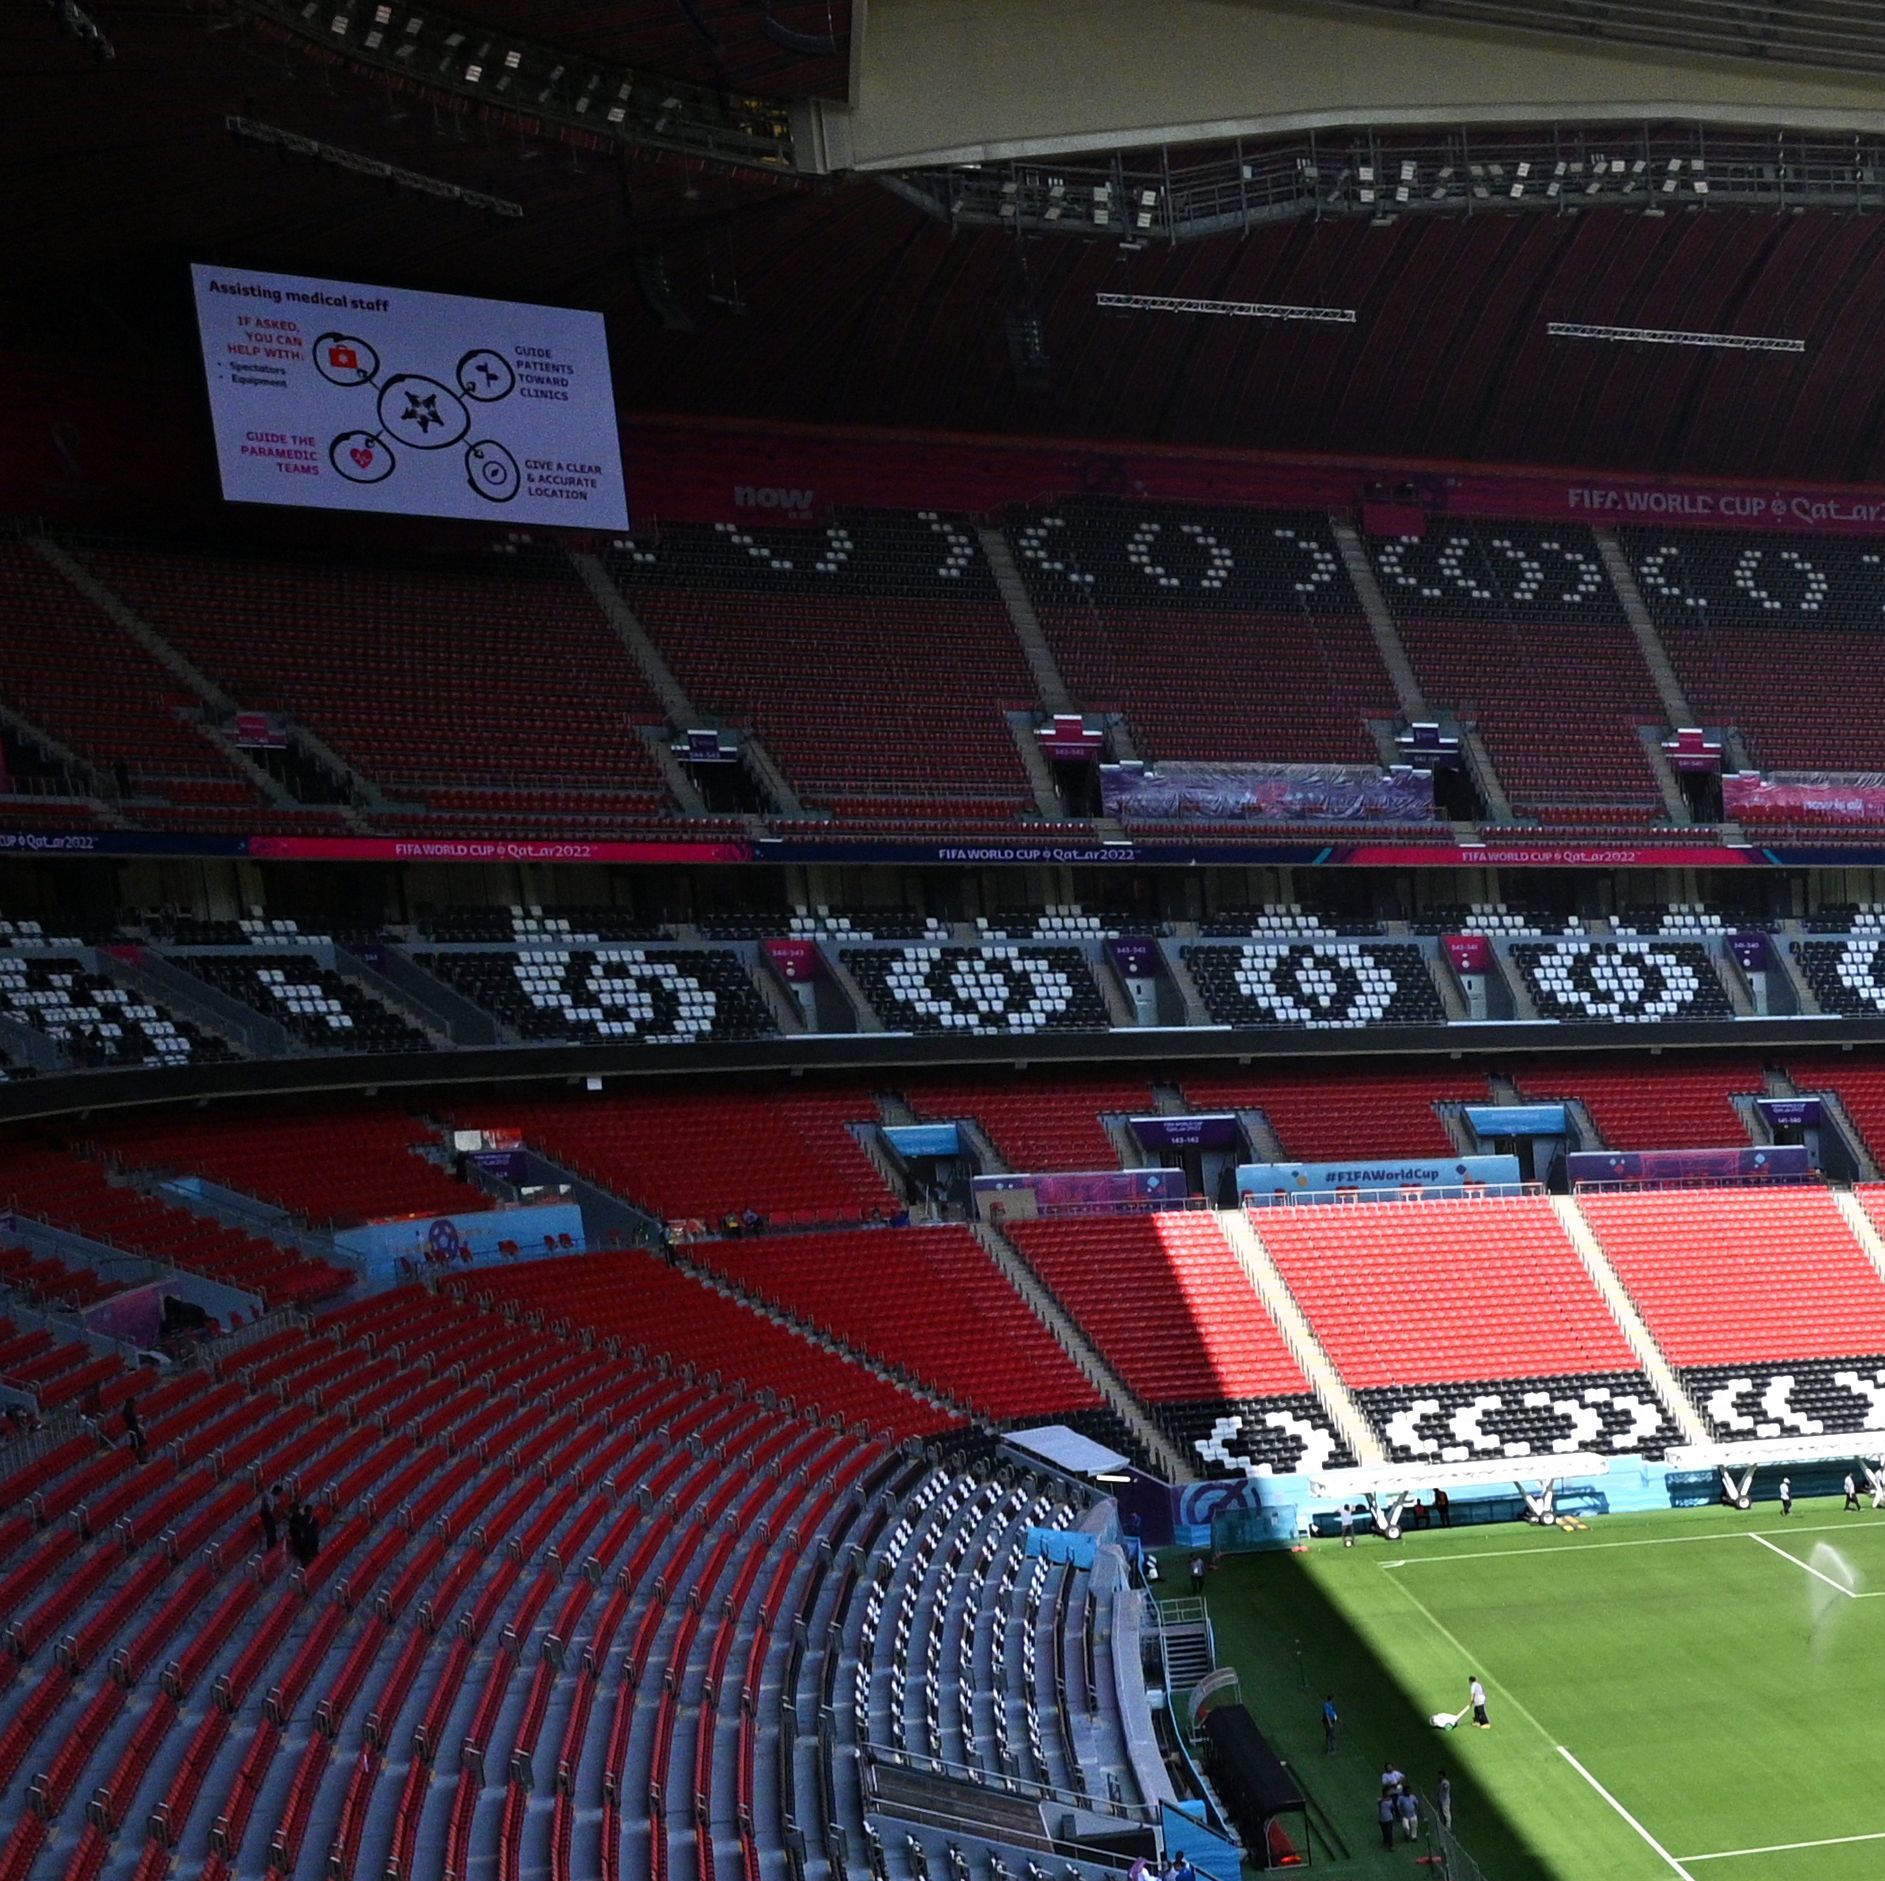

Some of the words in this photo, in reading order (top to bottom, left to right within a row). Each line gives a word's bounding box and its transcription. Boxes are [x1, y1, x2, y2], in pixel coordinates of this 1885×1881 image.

[209, 280, 282, 304] Assisting
[286, 291, 347, 308] medical
[351, 298, 389, 313] staff
[238, 316, 254, 326] IF
[246, 331, 273, 343] YOU
[276, 335, 302, 347] CAN
[228, 344, 260, 356] HELP
[515, 345, 552, 359] GUIDE
[229, 361, 286, 376] Spectators
[516, 359, 574, 375] PATIENTS
[231, 374, 288, 389] Equipment
[518, 373, 569, 388] TOWARD
[520, 387, 569, 401] CLINICS
[246, 431, 288, 444] GUIDE
[291, 435, 316, 447] THE
[241, 445, 318, 461] PARAMEDIC
[276, 461, 320, 476] TEAMS
[525, 459, 553, 471] GIVE
[557, 462, 564, 472] A
[566, 462, 602, 475] CLEAR
[538, 474, 598, 489] ACCURATE
[528, 486, 588, 501] LOCATION
[734, 485, 816, 509] now
[1567, 488, 1622, 510] FIFA
[1624, 491, 1715, 514] WORLD
[1719, 495, 1766, 517] CUP
[395, 843, 423, 857] FIFA
[422, 844, 468, 858] WORLD
[469, 844, 495, 857] CUP
[938, 849, 968, 861] FIFA
[967, 849, 1013, 862] WORLD
[1013, 849, 1041, 862] CUP
[1461, 852, 1488, 862] FIFA
[1487, 852, 1529, 863] WORLD
[1530, 852, 1553, 863] CUP
[1325, 1168, 1440, 1183] #FIFAWorldCup
